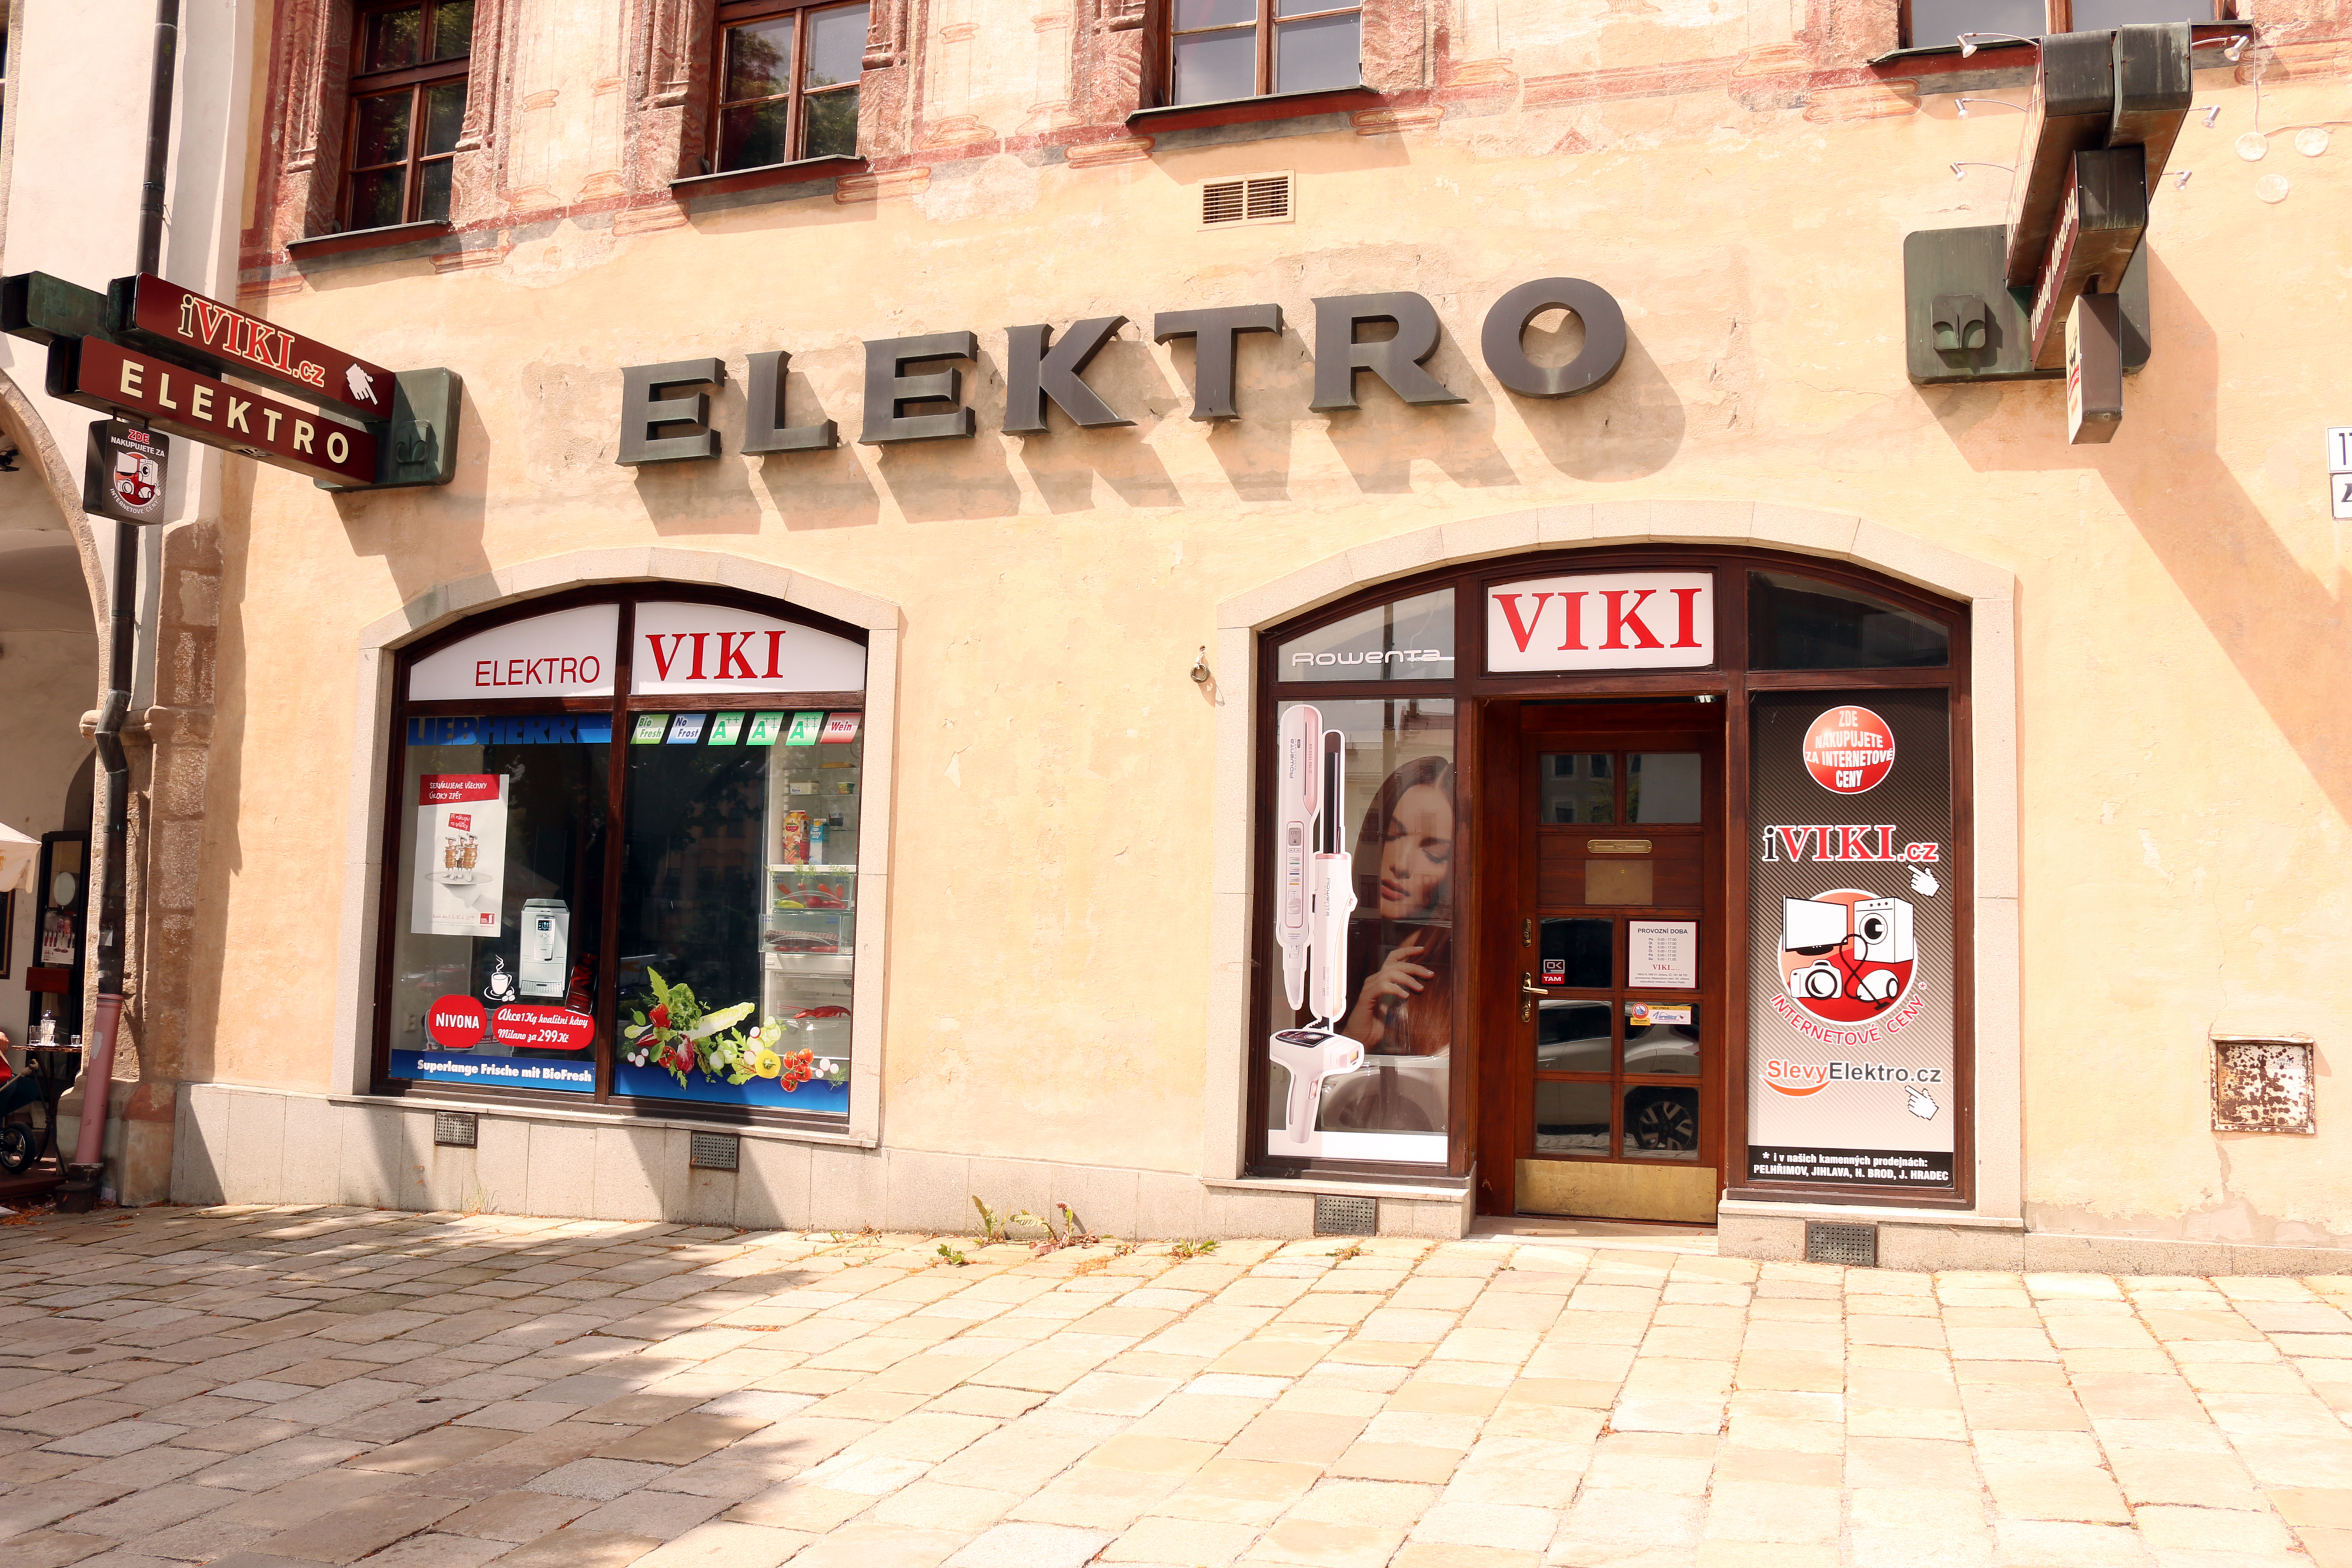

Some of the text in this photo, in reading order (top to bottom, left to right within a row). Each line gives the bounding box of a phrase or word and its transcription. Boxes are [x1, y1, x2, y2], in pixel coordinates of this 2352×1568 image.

[2031, 309, 2036, 342] U
[178, 294, 326, 388] iVIKI.cz
[616, 276, 1627, 467] ELEKTRO
[120, 359, 349, 464] ELEKTRO
[128, 429, 150, 444] ZDE
[111, 436, 165, 457] NAKUPUJETE ZA
[146, 499, 159, 513] CENY
[1492, 588, 1703, 653] VIKI
[475, 630, 786, 687] ELEKTRO VIKI
[1292, 648, 1441, 667] Rowenta
[638, 716, 652, 727] Bio
[675, 717, 687, 727] No
[831, 721, 853, 732] Wein
[1839, 710, 1859, 728] ZDE
[407, 714, 577, 745] LIEBHERR
[639, 727, 662, 738] Fresh
[677, 728, 699, 738] Frost
[1815, 730, 1883, 749] NAKUPUJETE
[1805, 747, 1893, 768] ZA INTERNETOVÉ
[1835, 769, 1863, 788] CENY
[1762, 824, 1939, 863] iVIKI.cz
[436, 1012, 480, 1029] NIVONA
[537, 1013, 569, 1025] kvalitní
[568, 1015, 589, 1029] kávy
[1770, 993, 1926, 1046] INTERNETOVÉ CENY
[497, 1028, 527, 1040] Milano
[417, 1059, 592, 1082] Superlange Frische mit BioFresh
[1766, 1059, 1943, 1085] SlevyElektro.cz
[1773, 1152, 1777, 1162] i
[1786, 1153, 1818, 1164] našich
[1819, 1154, 1870, 1166] kamenných
[1873, 1156, 1928, 1168] prodejnách:
[1753, 1164, 1949, 1181] PELHŘIMOV, JIHLAVA, H. BROD, J. HRADEC
